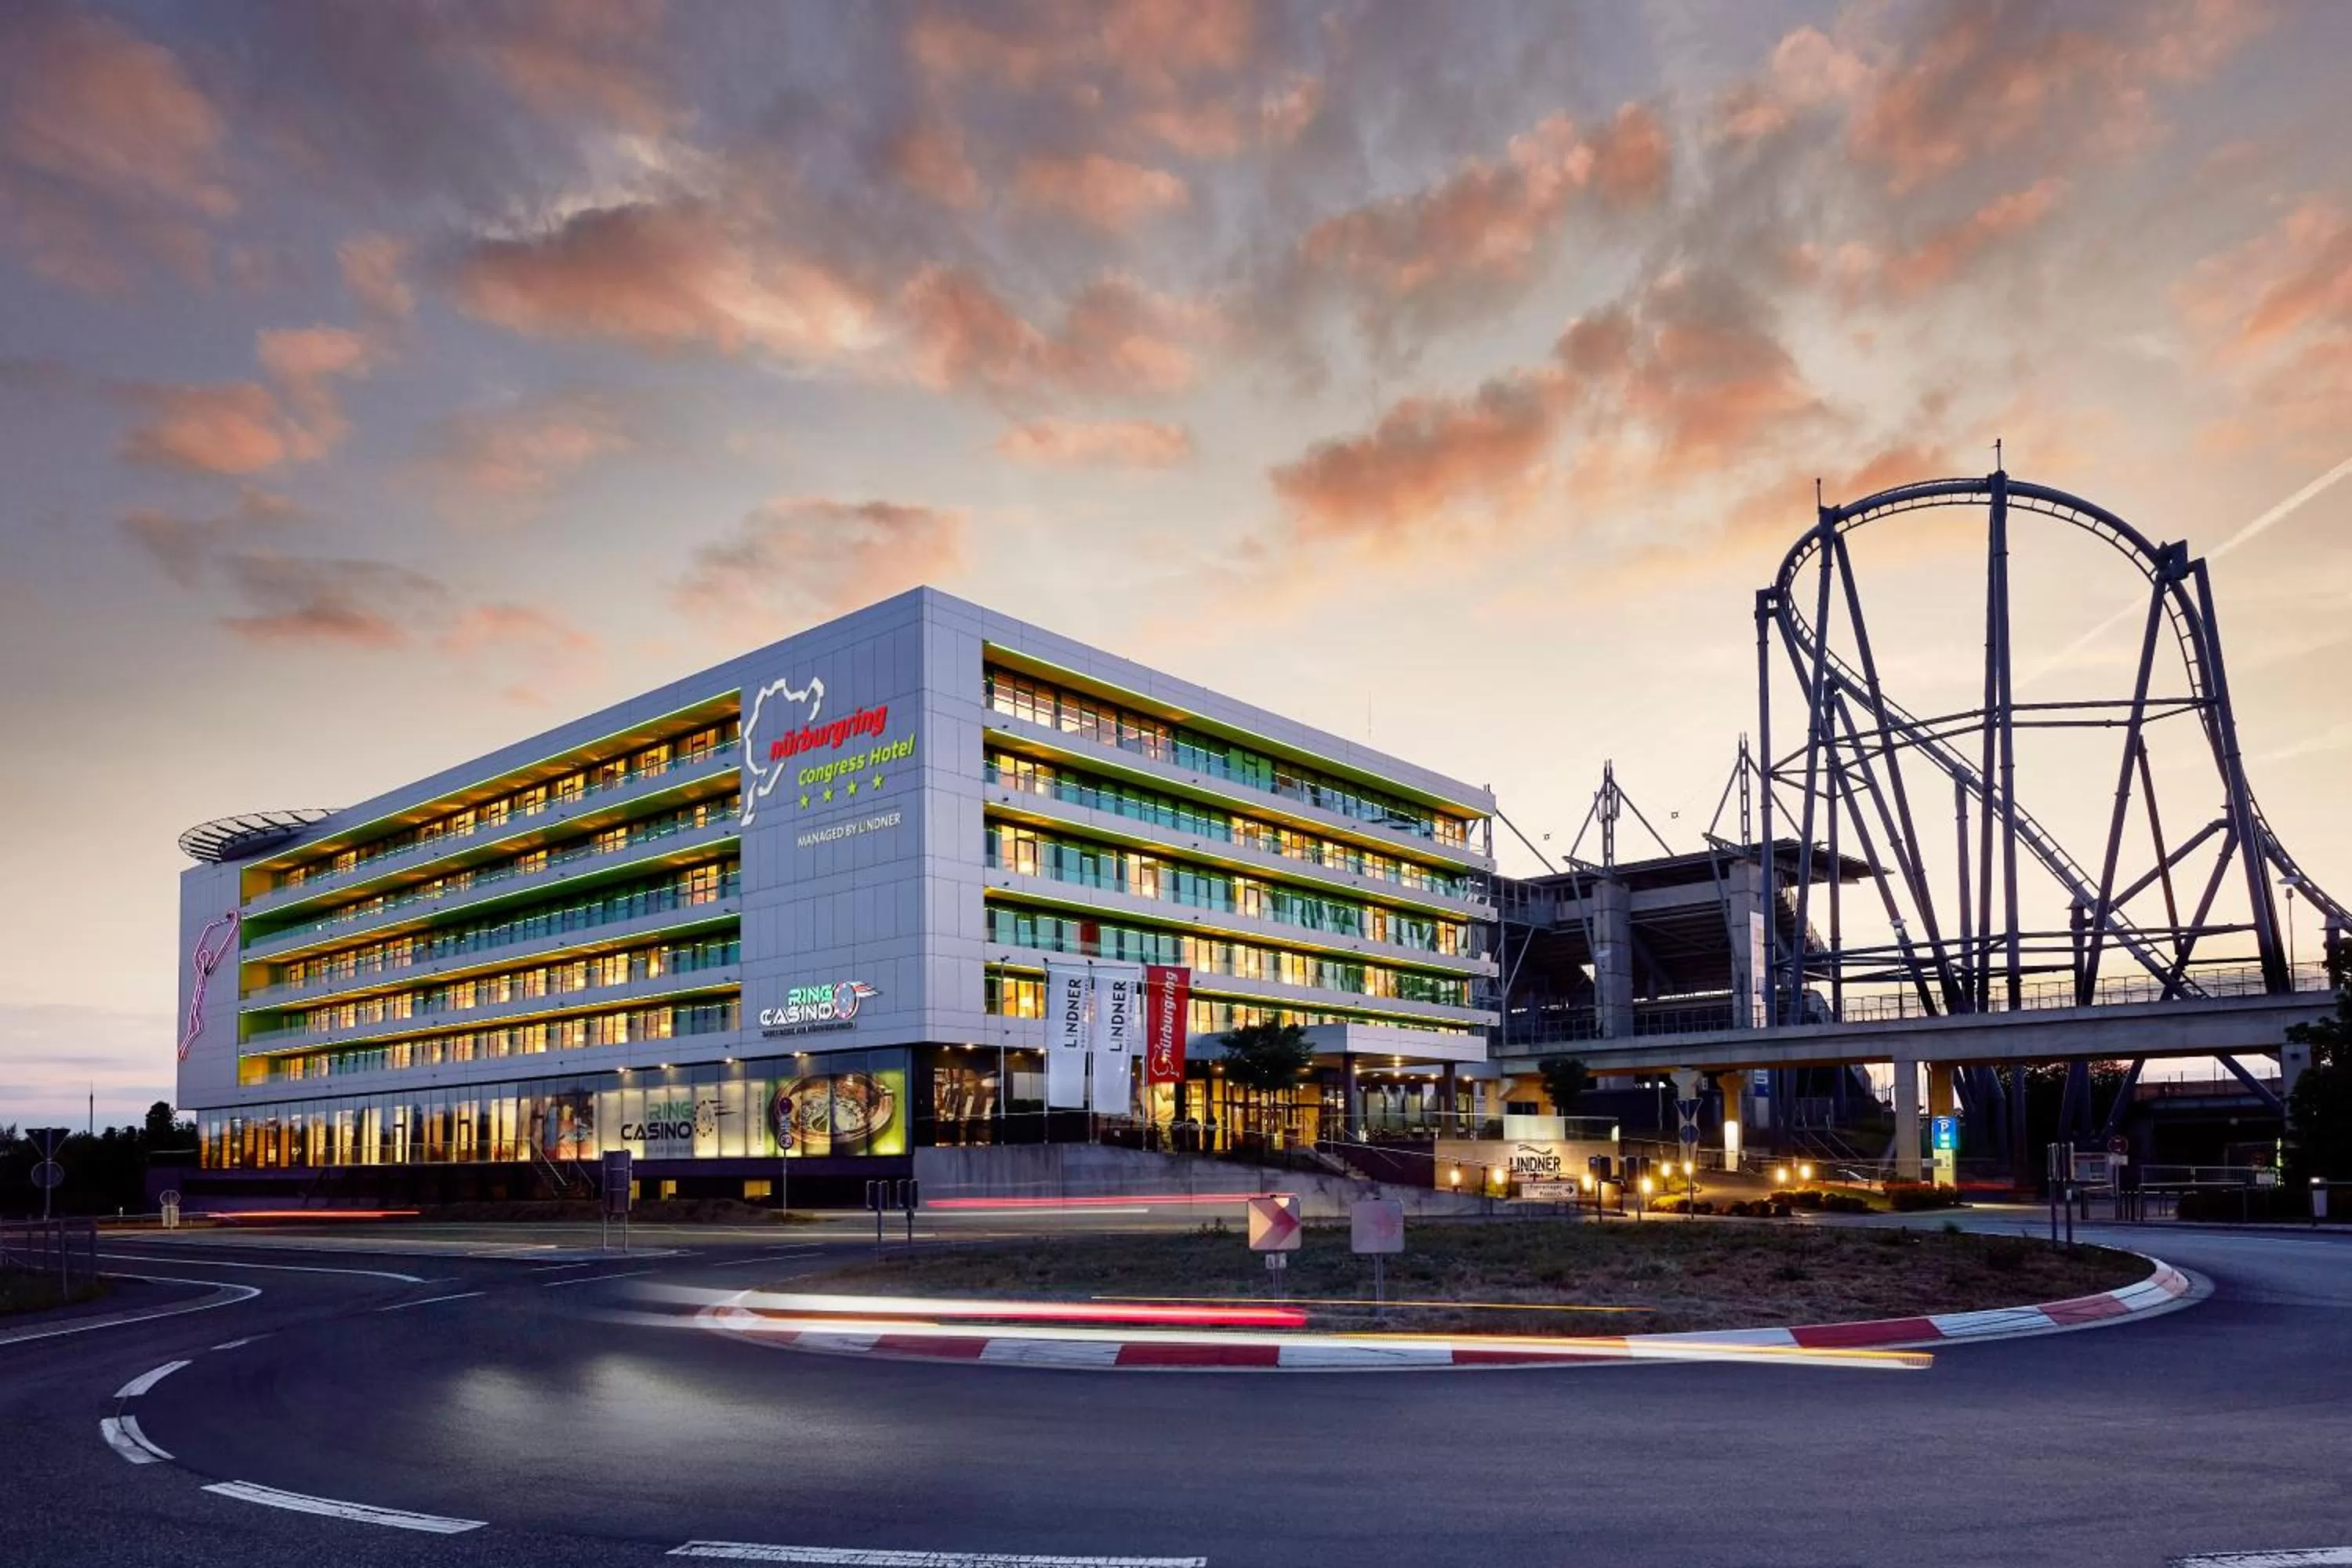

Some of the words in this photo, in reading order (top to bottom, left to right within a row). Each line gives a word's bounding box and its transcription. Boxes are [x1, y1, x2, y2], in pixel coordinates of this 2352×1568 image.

[770, 705, 887, 762] nürburgring
[798, 753, 865, 786] Congress
[869, 733, 916, 765] Hotel
[797, 826, 844, 848] MANAGED
[846, 823, 858, 837] BY
[858, 812, 902, 835] LINDNER
[788, 984, 834, 1006] RING
[1064, 978, 1082, 1048] LINDNER
[760, 1003, 834, 1025] CASINO
[1109, 981, 1127, 1052] LINDNER
[1161, 971, 1178, 1058] nürburgring
[648, 1101, 692, 1120] RING
[621, 1121, 692, 1140] CASINO
[1509, 1156, 1561, 1172] LINDNER
